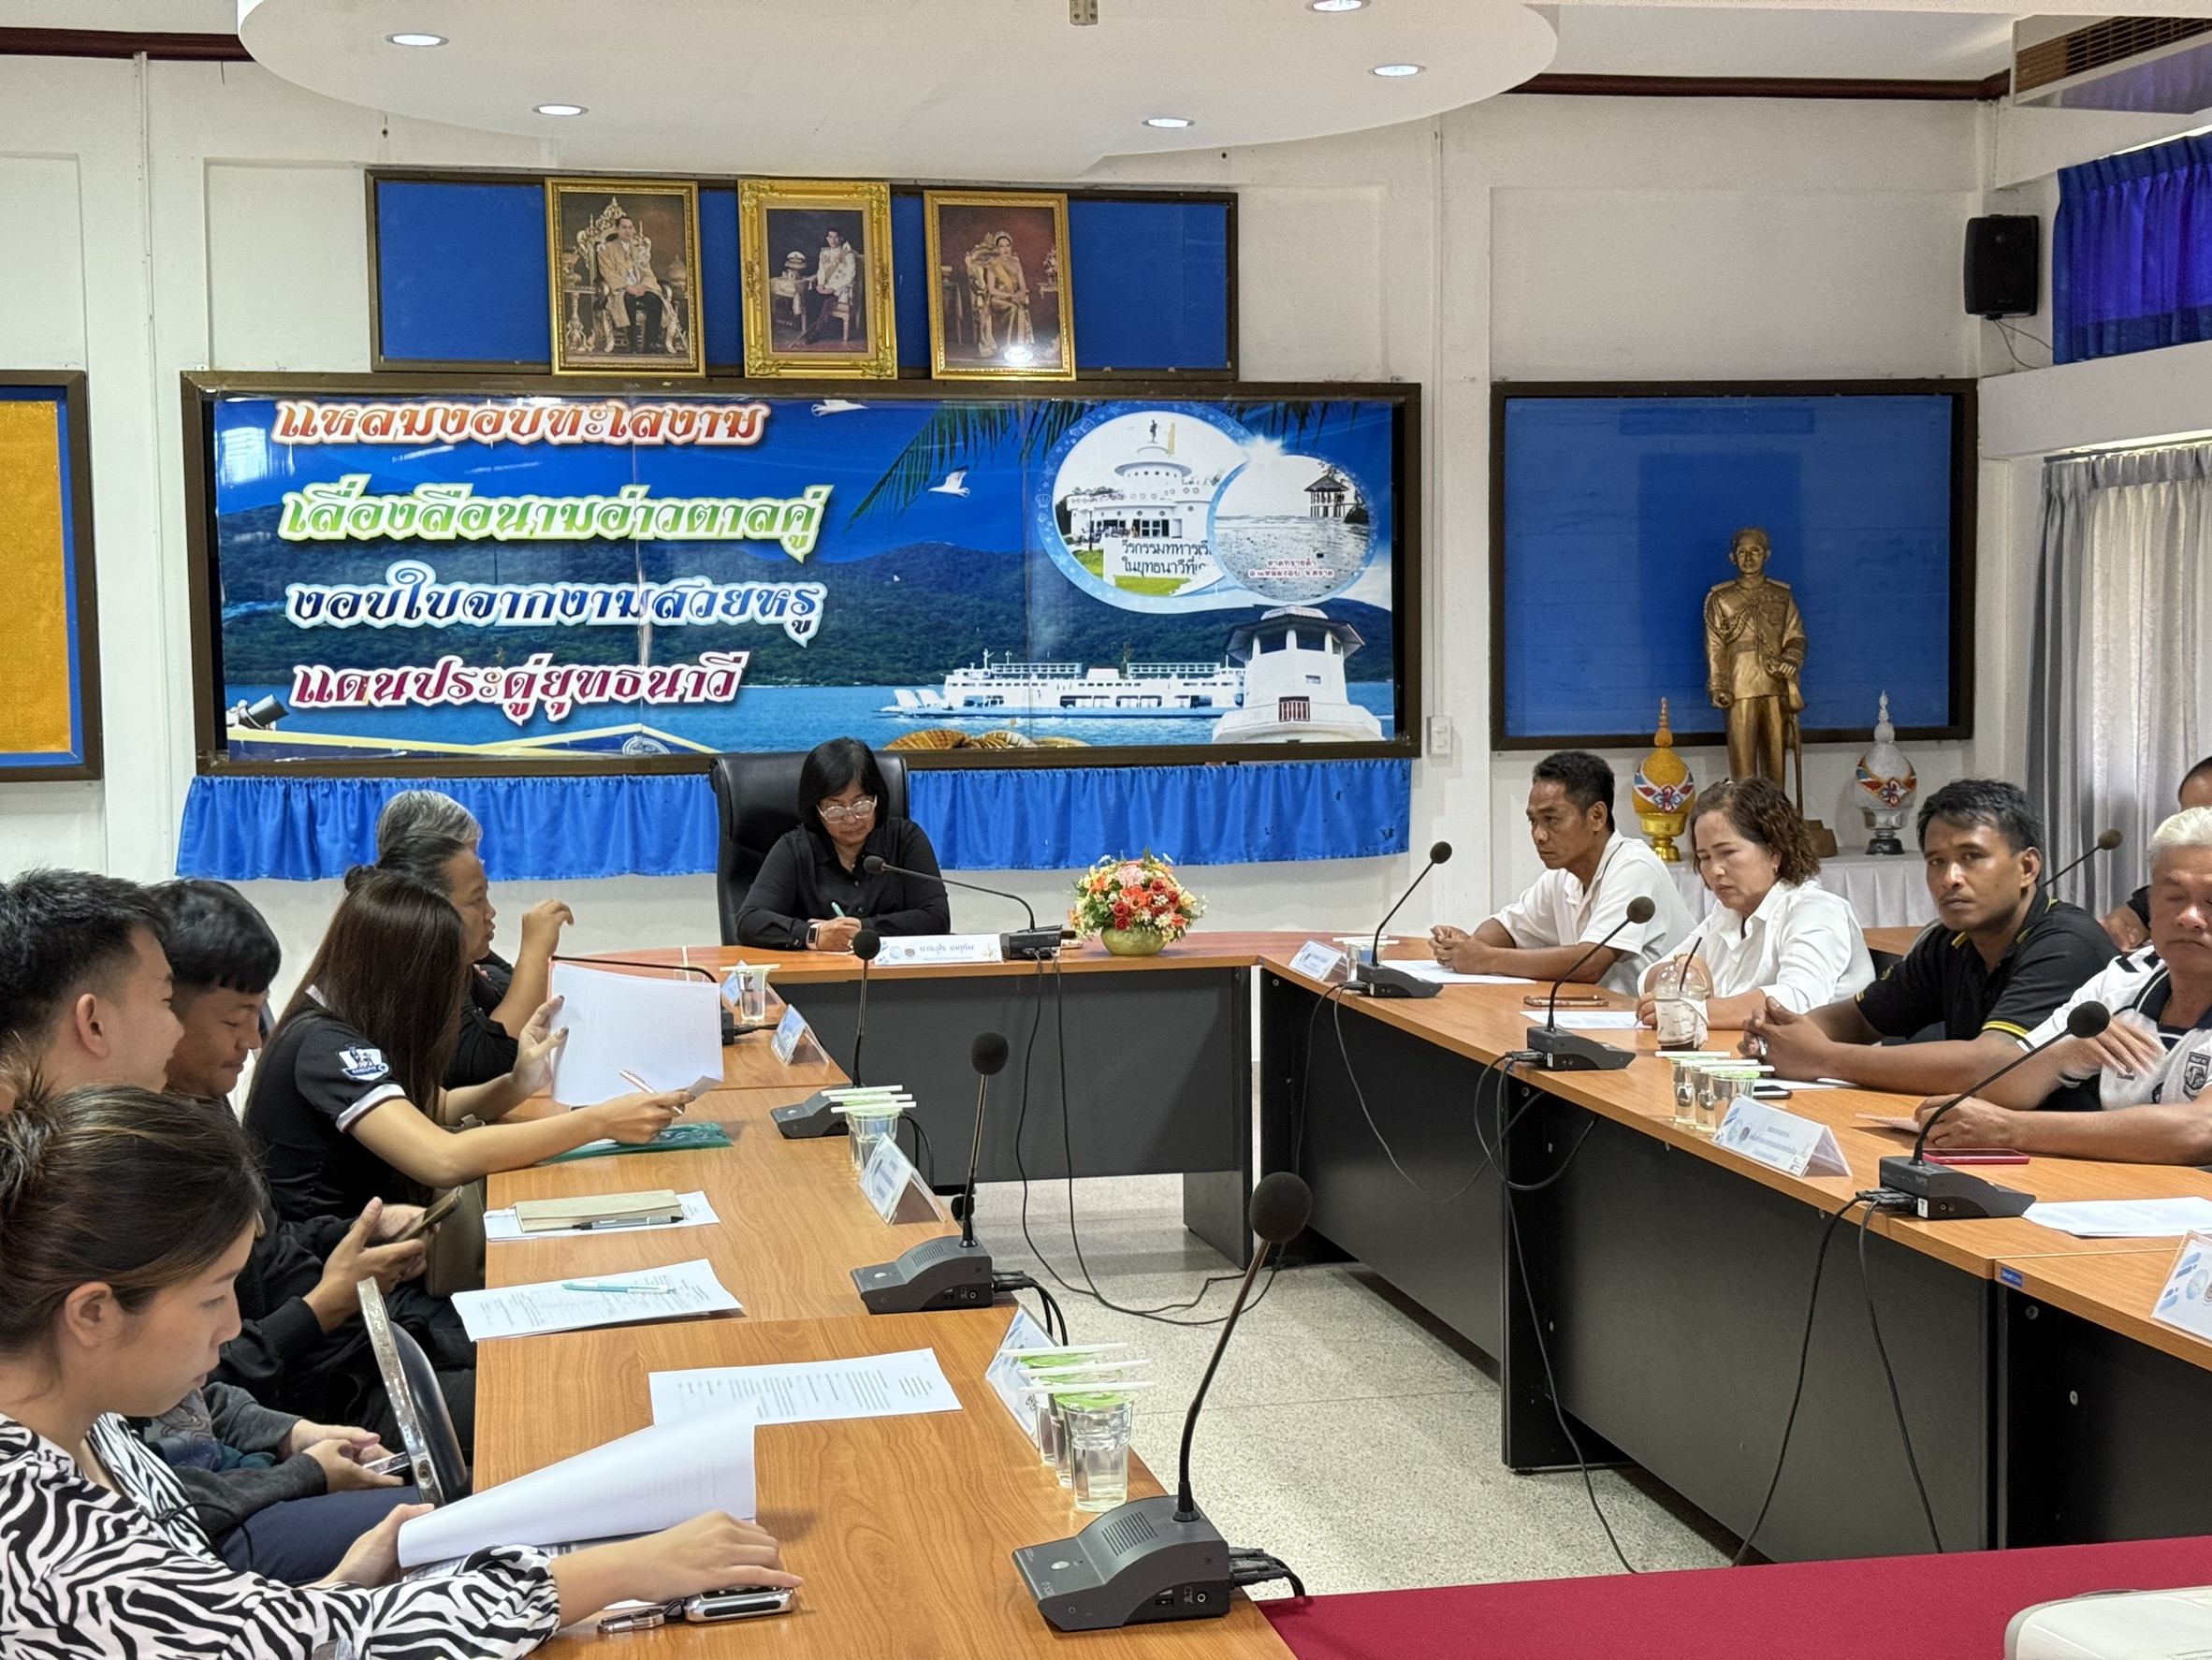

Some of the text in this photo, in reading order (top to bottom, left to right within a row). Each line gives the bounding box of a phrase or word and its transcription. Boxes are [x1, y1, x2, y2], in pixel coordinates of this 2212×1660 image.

[274, 402, 763, 443] แหลมงอบทะเลงาม
[283, 477, 828, 556] เลื่องลือนามอ่าวตาลคู่
[1122, 540, 1212, 556] วีรกรรมทหารเรื
[289, 564, 824, 640] งอบใบจากงามสวยหรู
[292, 654, 747, 721] แดนประดู่ยุทธนาวี
